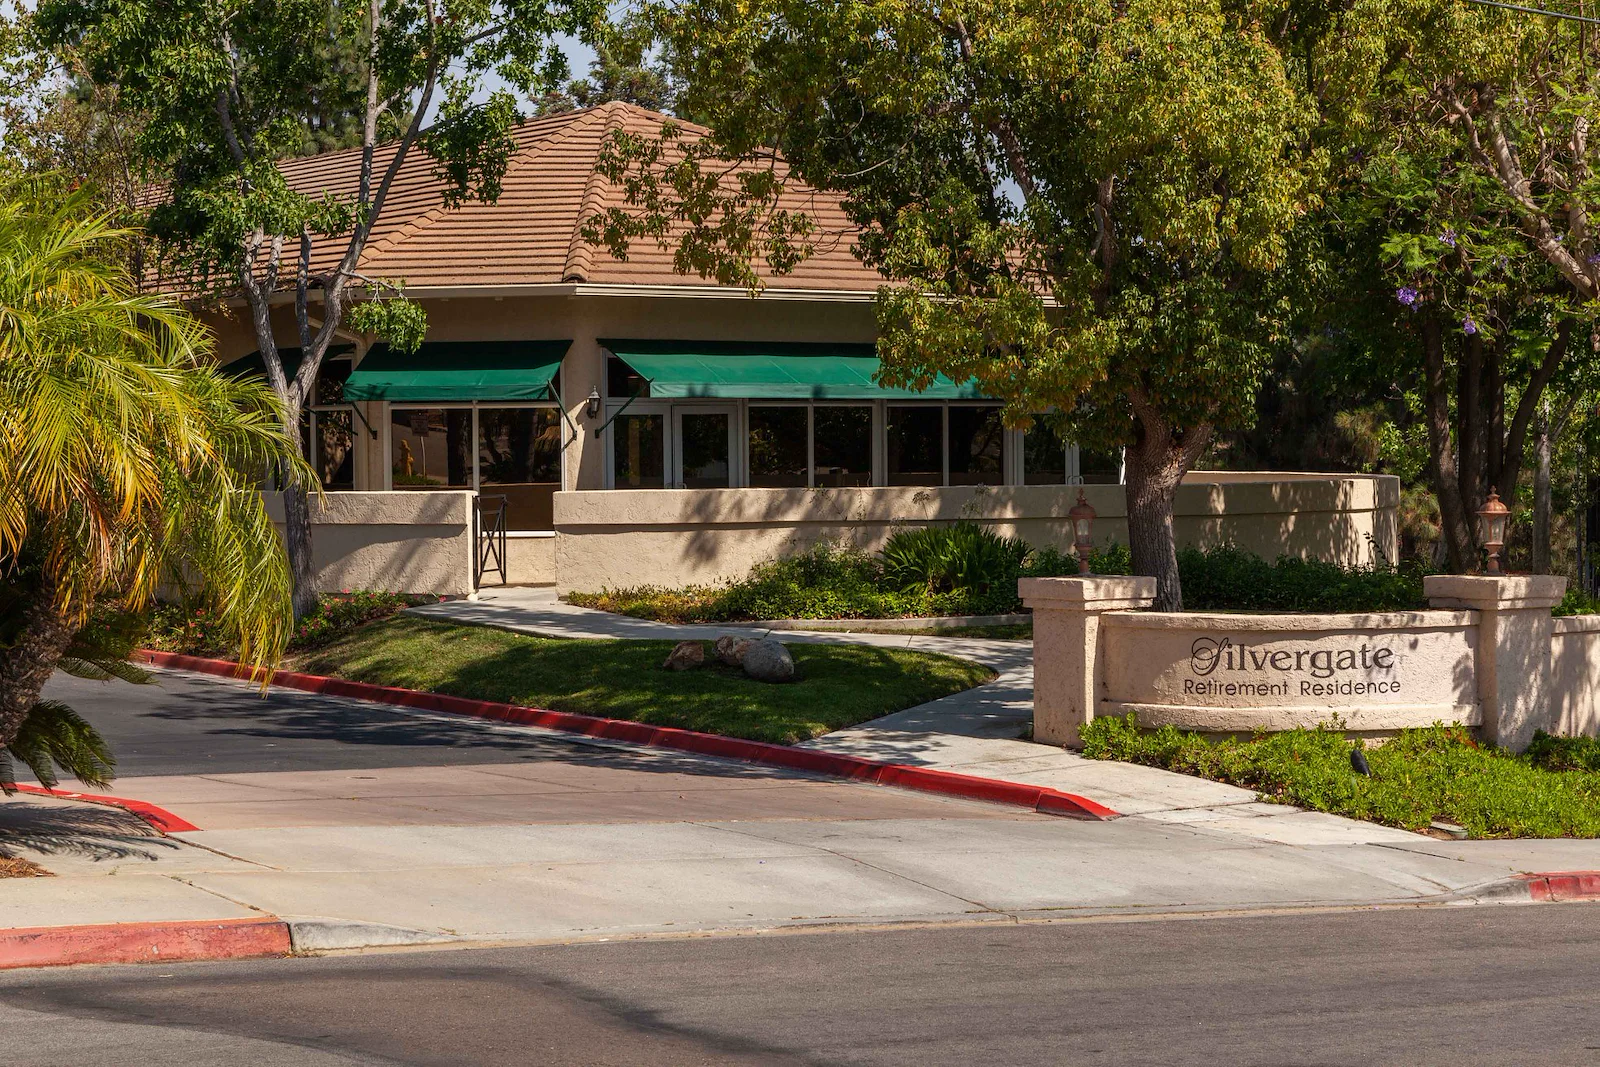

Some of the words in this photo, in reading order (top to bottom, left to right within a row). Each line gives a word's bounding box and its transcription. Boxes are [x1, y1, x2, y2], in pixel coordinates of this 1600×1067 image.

[1191, 637, 1394, 678] Silvergate
[1184, 680, 1288, 695] Retirement
[1300, 680, 1401, 696] Residence
